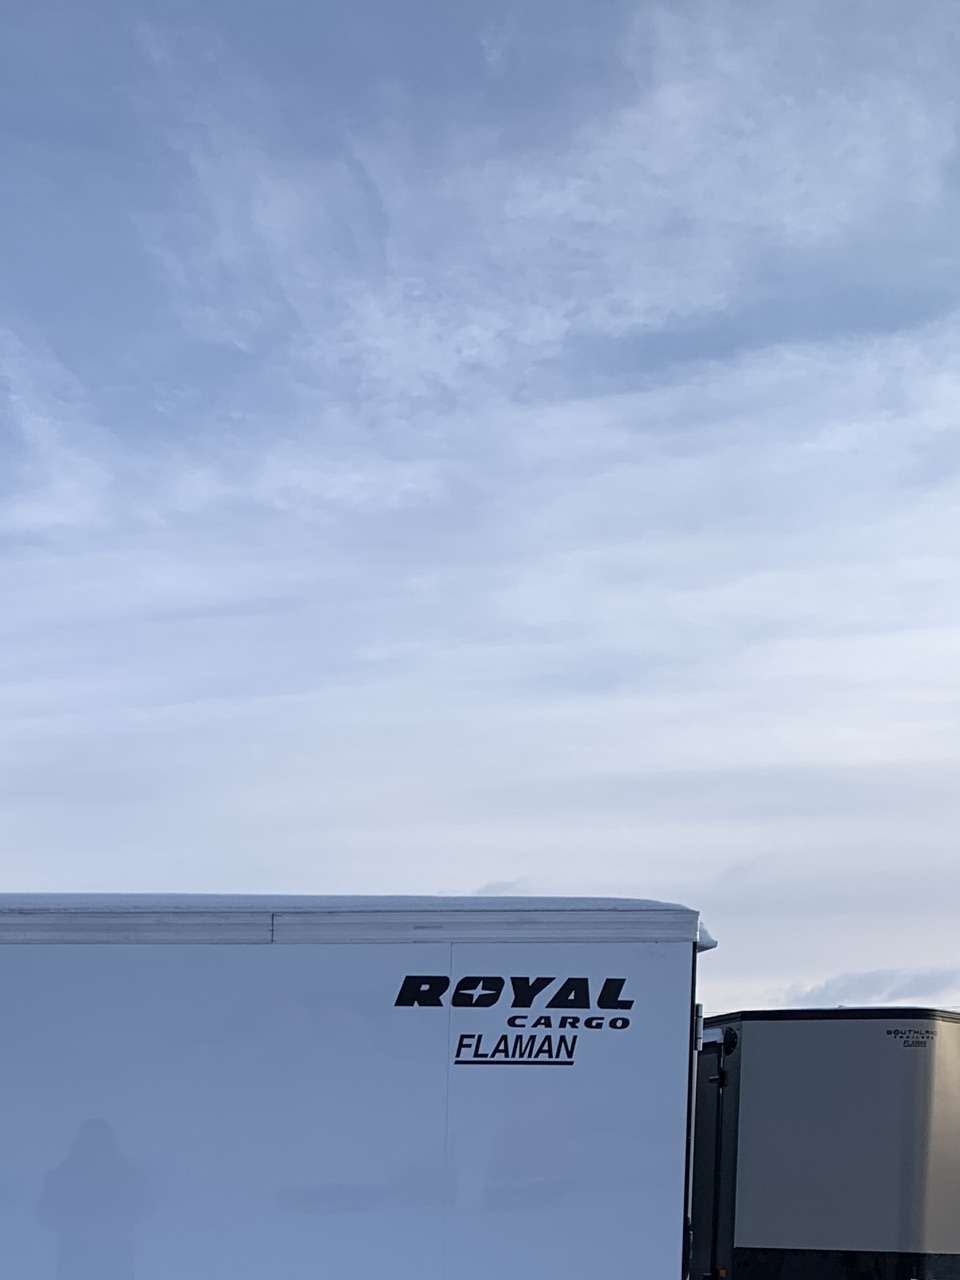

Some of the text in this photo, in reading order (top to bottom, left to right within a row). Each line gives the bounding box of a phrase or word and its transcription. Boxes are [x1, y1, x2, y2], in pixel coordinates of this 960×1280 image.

[394, 975, 636, 1010] ROYAL
[506, 1015, 631, 1030] CARGO
[454, 1034, 578, 1060] FLAMAN
